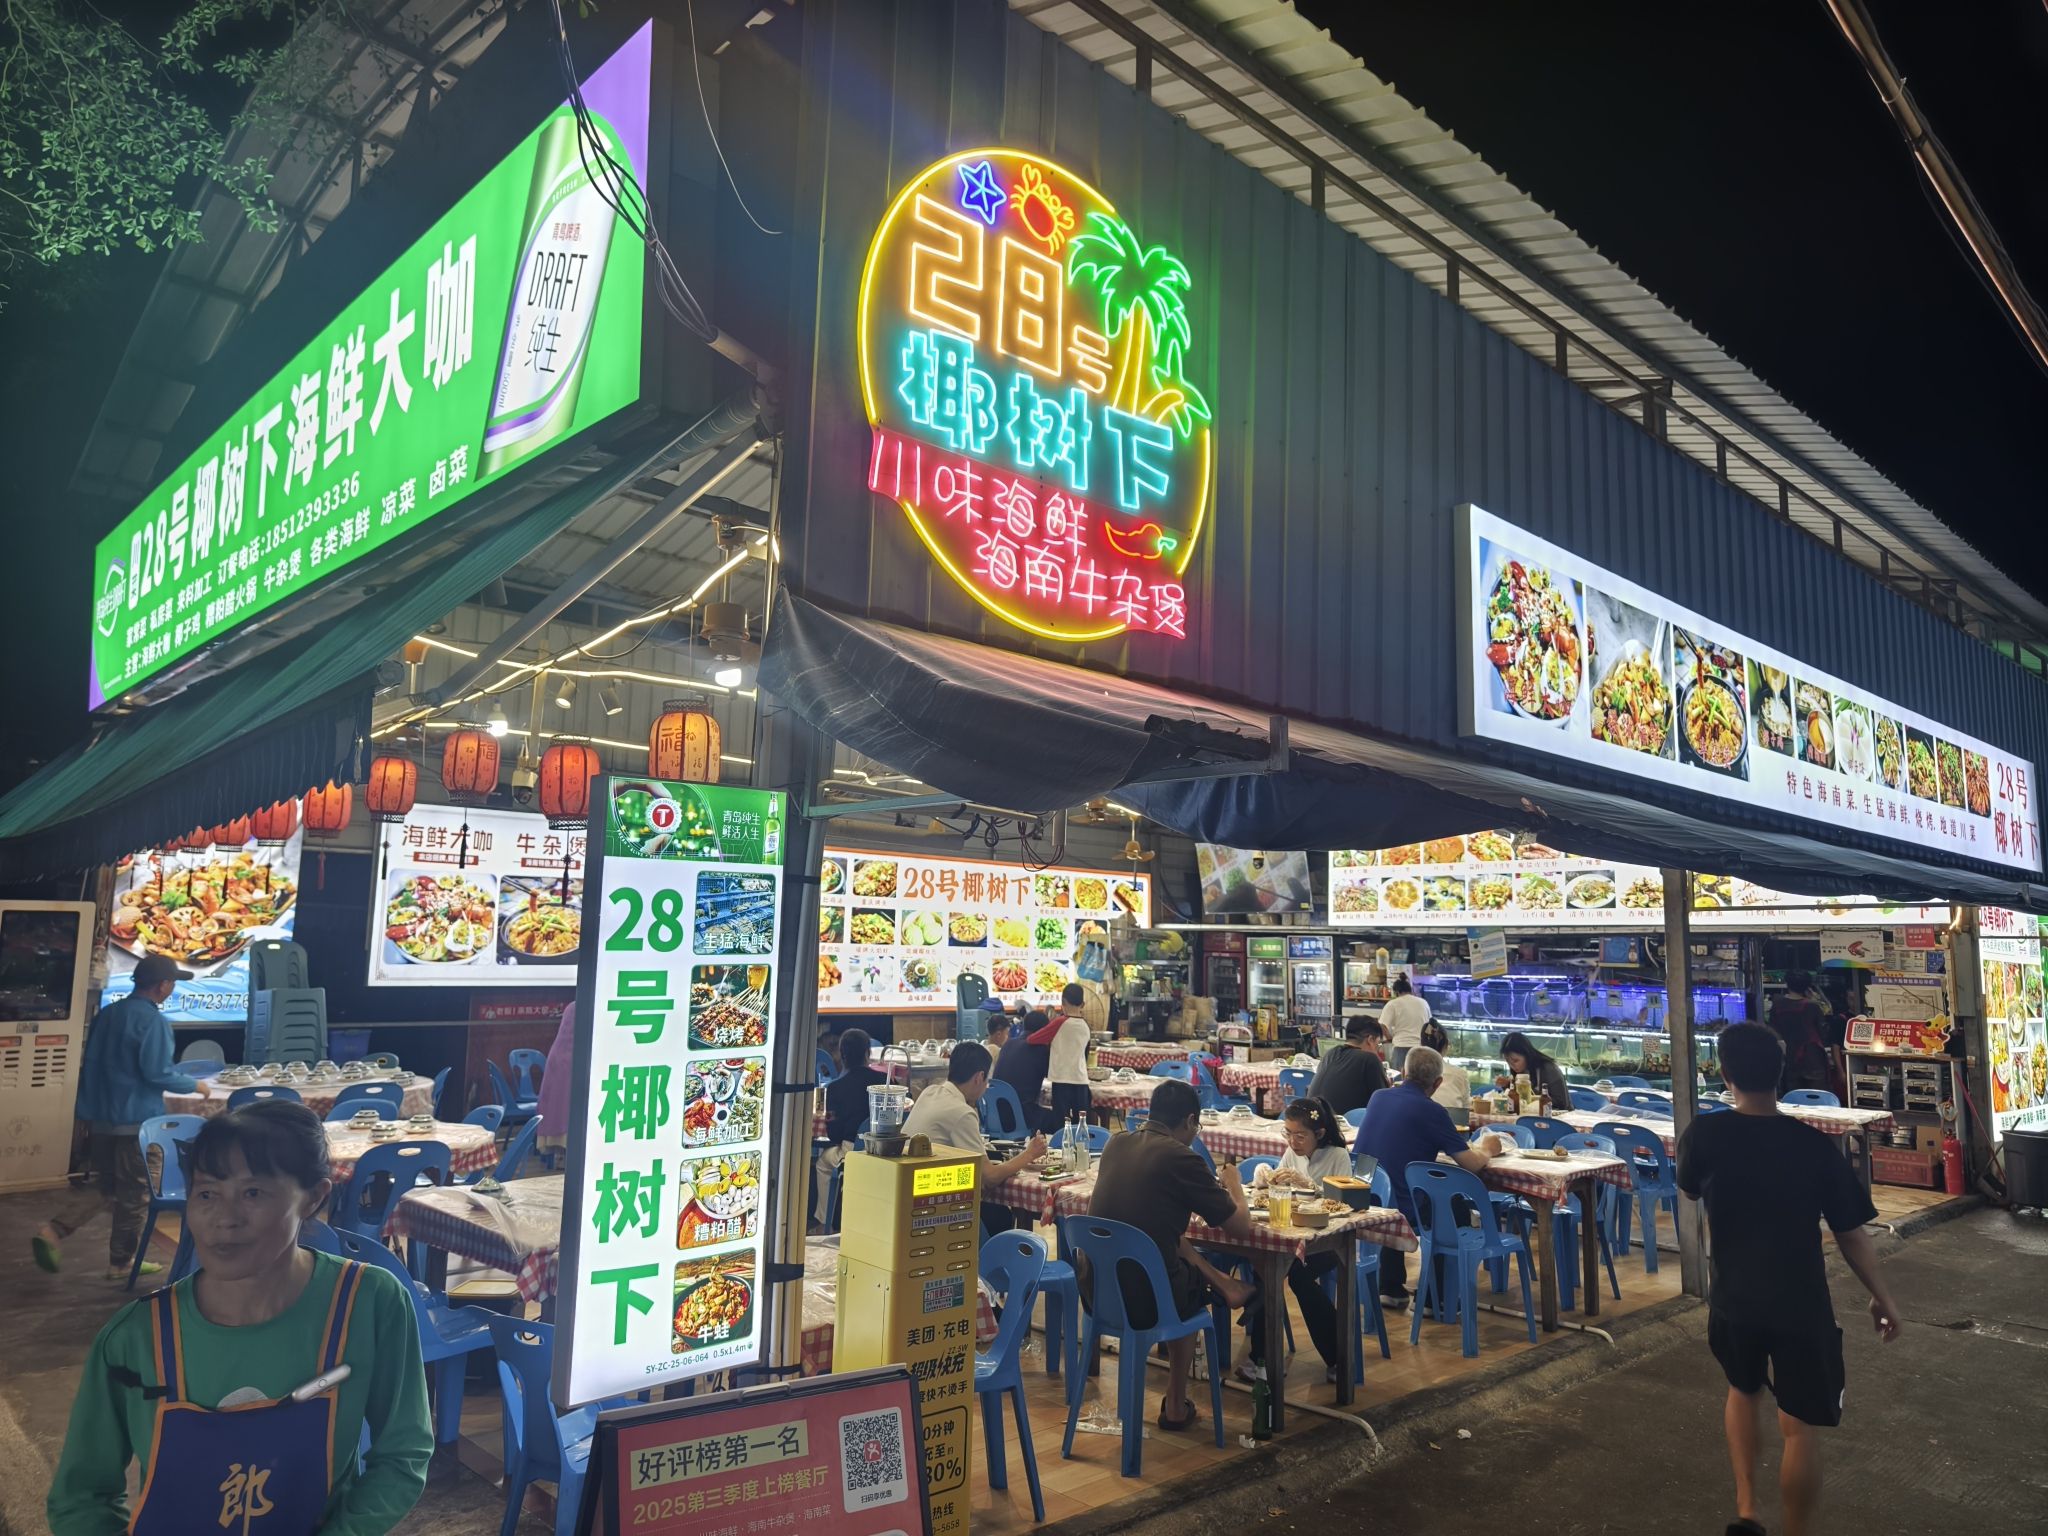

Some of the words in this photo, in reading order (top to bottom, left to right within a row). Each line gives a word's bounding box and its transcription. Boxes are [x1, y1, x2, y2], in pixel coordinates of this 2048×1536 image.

[528, 251, 588, 312] DRAFT
[908, 193, 1113, 394] 28号
[523, 315, 562, 373] 纯生
[139, 233, 477, 598] 28号椰树下海鲜大咖
[899, 327, 1175, 511] 椰树下
[871, 434, 1089, 558] 川味海鲜
[124, 632, 172, 679] 主营:海鲜大咖
[174, 611, 201, 649] 椰子鸡
[205, 575, 258, 629] 糟粕醋火锅
[263, 547, 302, 593] 牛杂煲
[310, 506, 371, 568] 各类海鲜
[380, 477, 417, 526] 凉菜
[428, 444, 469, 500] 卤菜
[150, 597, 174, 632] 私房菜
[177, 570, 213, 613] 来料加工
[218, 470, 361, 586] 订餐电话:18512393336
[973, 528, 1187, 639] 海南牛杂煲
[1997, 762, 2028, 811] 28号
[402, 824, 493, 852] 海鲜大咖
[516, 833, 587, 857] 牛杂煲
[721, 824, 760, 841] 鲜活人生
[722, 809, 761, 826] 青岛纯生
[1994, 807, 2039, 862] 椰树下
[903, 866, 1031, 907] 28号椰树下
[703, 932, 766, 950] 生猛海鲜
[713, 1026, 745, 1045] 烧烤
[590, 886, 684, 1346] 28号椰树下
[693, 1121, 755, 1143] 海鲜加工
[694, 1216, 742, 1243] 糟粕醋
[697, 1319, 731, 1344] 牛蛙
[907, 1318, 970, 1347] 美团·充电
[645, 1351, 709, 1375] SY-ZC-25-06-064
[713, 1344, 747, 1359] 0.5x1.4m
[910, 1352, 966, 1381] 超级快充
[638, 1425, 801, 1485] 好评榜第一名
[632, 1465, 830, 1526] 2025第三季度上榜餐厅
[860, 1488, 893, 1505] 扫码享优惠
